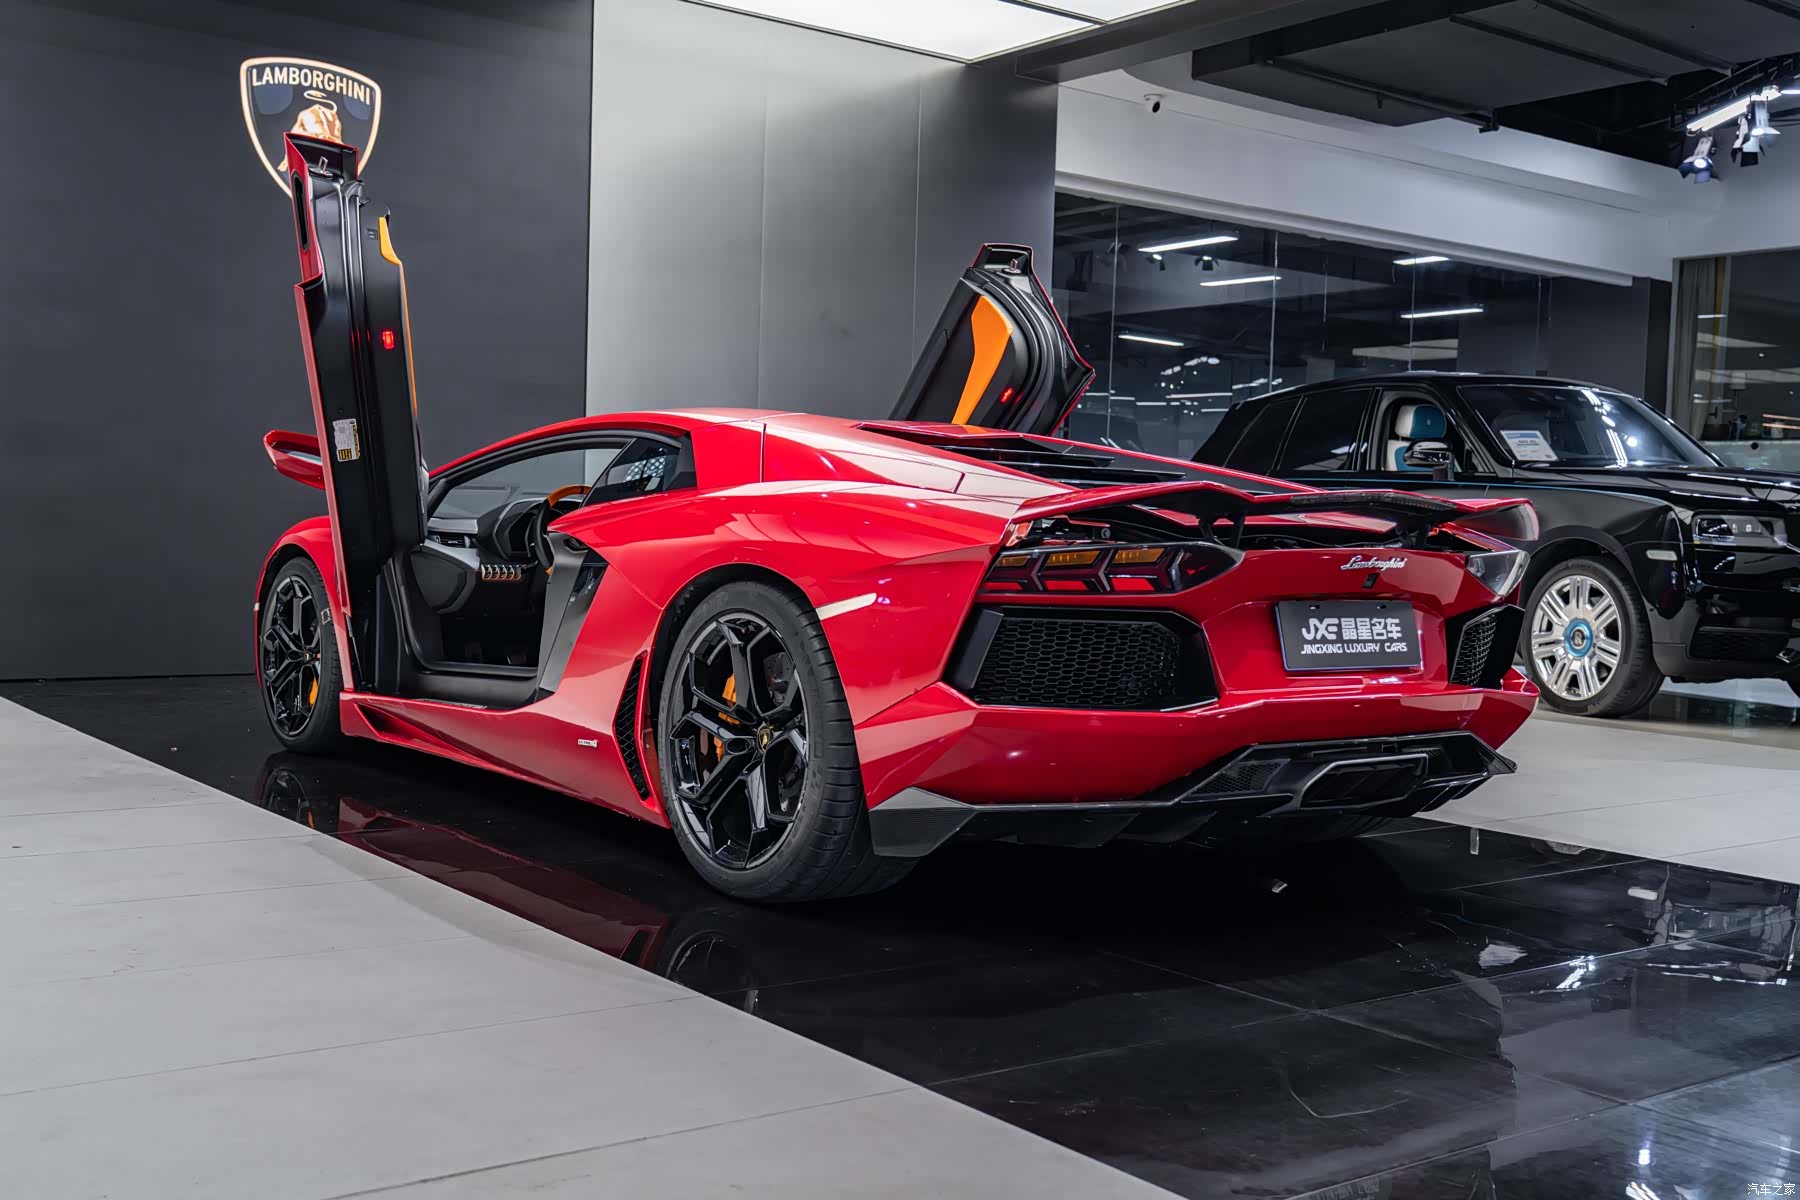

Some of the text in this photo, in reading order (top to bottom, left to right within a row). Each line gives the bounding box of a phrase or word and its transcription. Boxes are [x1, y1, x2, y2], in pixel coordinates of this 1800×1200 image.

[252, 66, 370, 105] LAMBORGHINI
[1340, 555, 1407, 571] Lamborghini
[1340, 617, 1402, 640] 晶星名车
[1301, 642, 1408, 654] JINGXING LUXURY CARS
